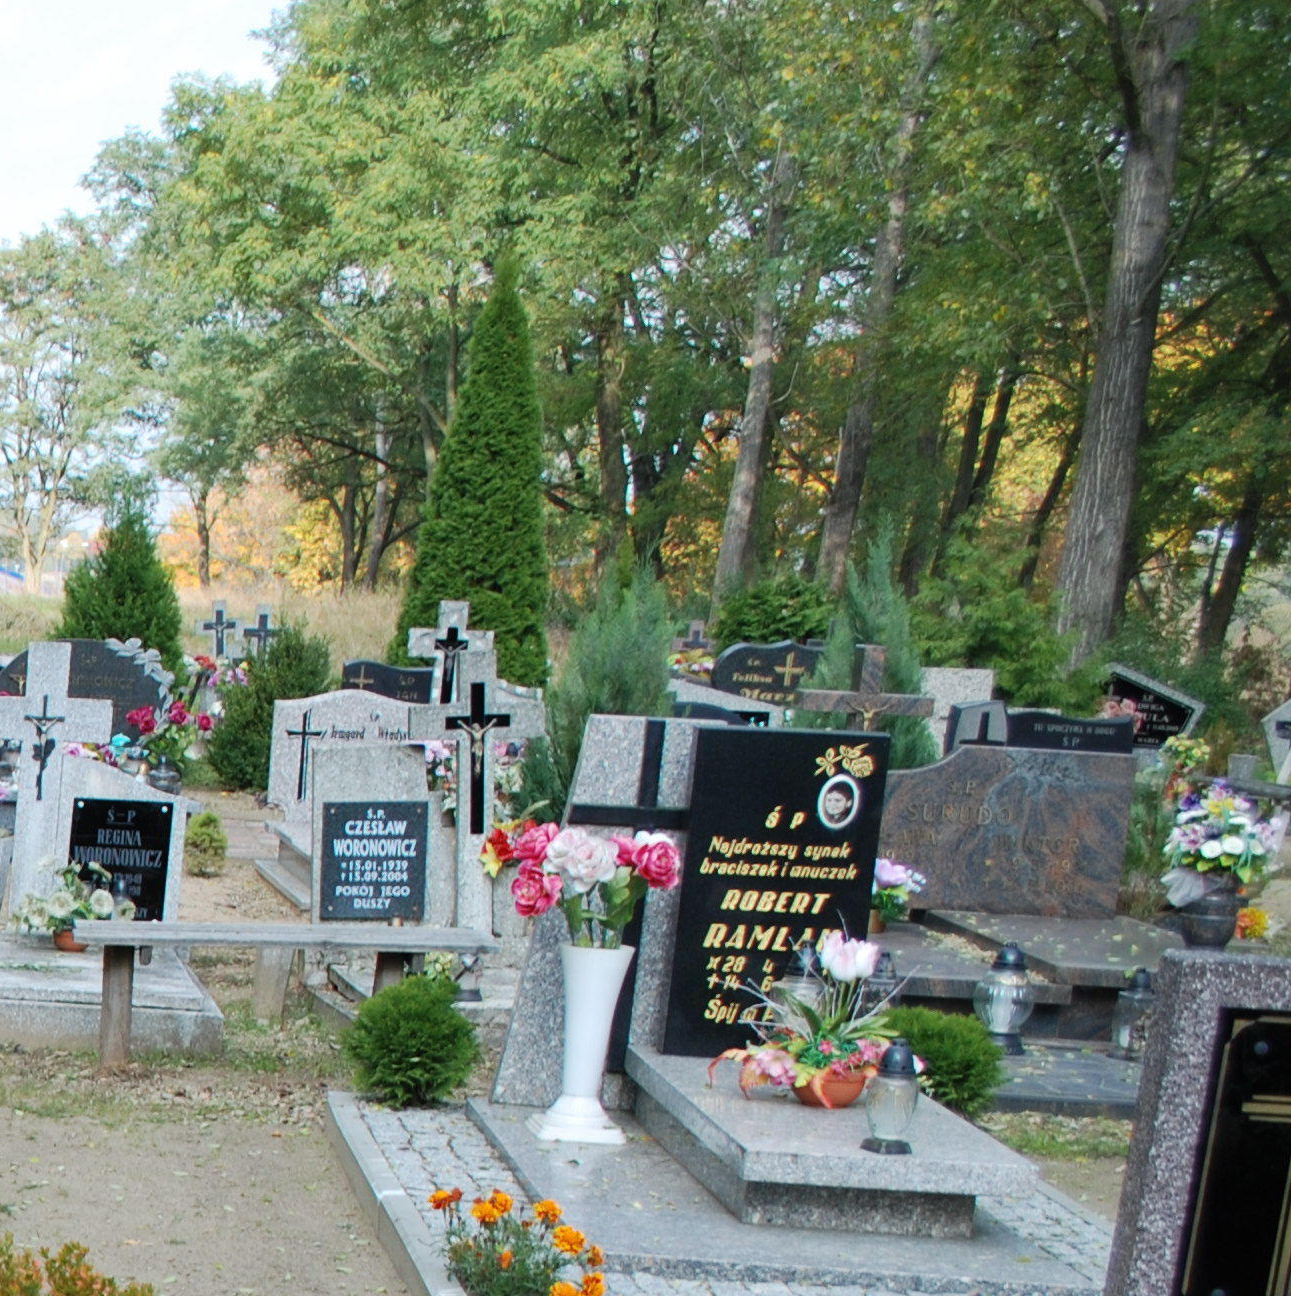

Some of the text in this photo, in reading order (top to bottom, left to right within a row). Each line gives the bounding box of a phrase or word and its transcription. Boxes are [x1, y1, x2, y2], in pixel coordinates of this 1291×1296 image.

[97, 829, 142, 847] REGINA
[345, 820, 407, 836] CZESŁAW
[74, 846, 163, 868] WORONOWICZ
[333, 838, 417, 858] WORONOWICZ
[708, 836, 852, 861] Najdroższy synek
[700, 857, 779, 878] braciszek
[789, 862, 858, 881] wnuczek
[335, 884, 411, 898] POKÓJ JEGO
[353, 898, 391, 910] DUSZY
[720, 889, 832, 915] ROBERT
[722, 955, 747, 973] 28
[704, 993, 740, 1025] Śpij
